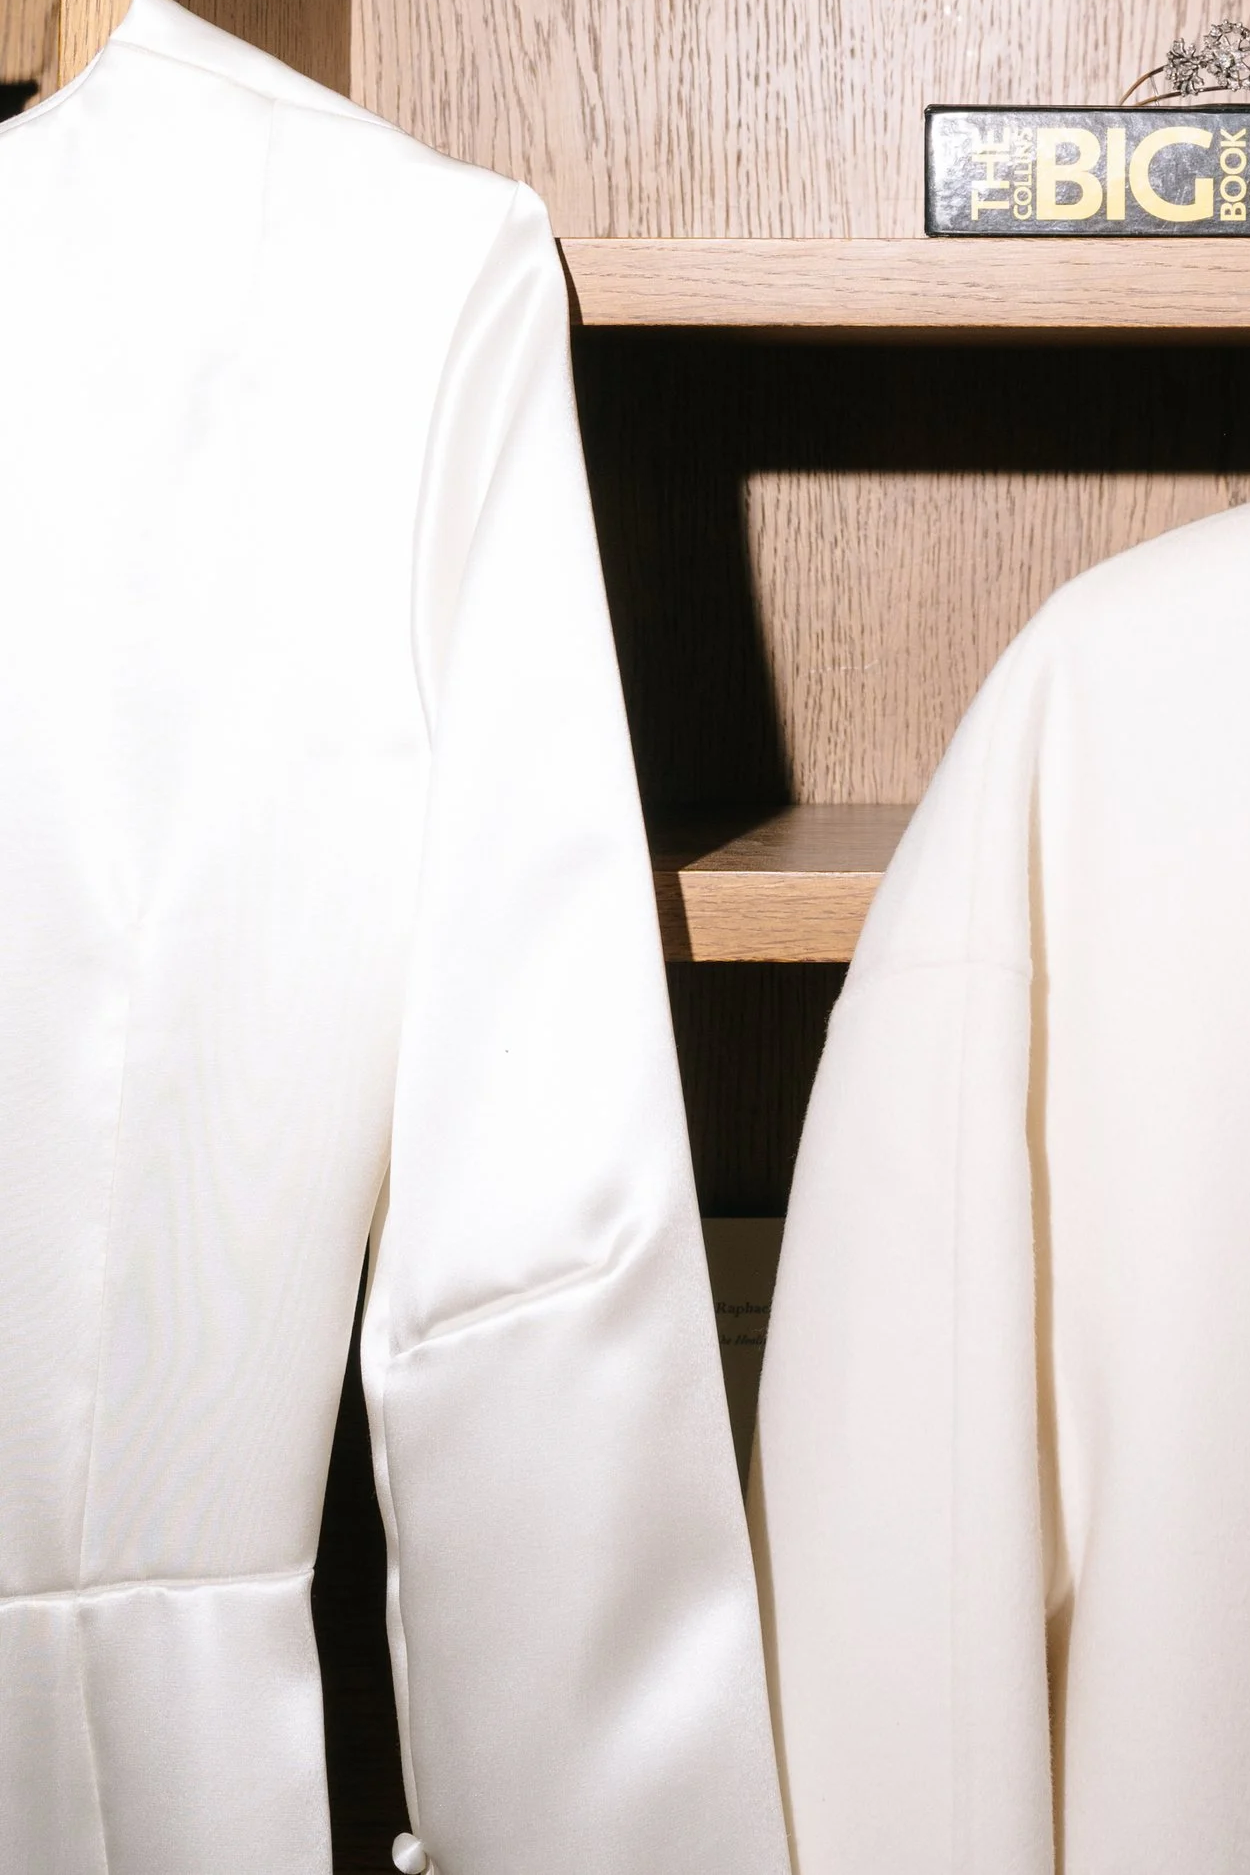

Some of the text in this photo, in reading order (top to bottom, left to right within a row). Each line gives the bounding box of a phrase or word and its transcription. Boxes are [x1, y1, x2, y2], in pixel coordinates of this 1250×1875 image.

[970, 127, 1010, 221] THE
[1013, 127, 1034, 221] COLLINS
[1036, 126, 1214, 223] BIG
[1219, 128, 1247, 221] BOOK
